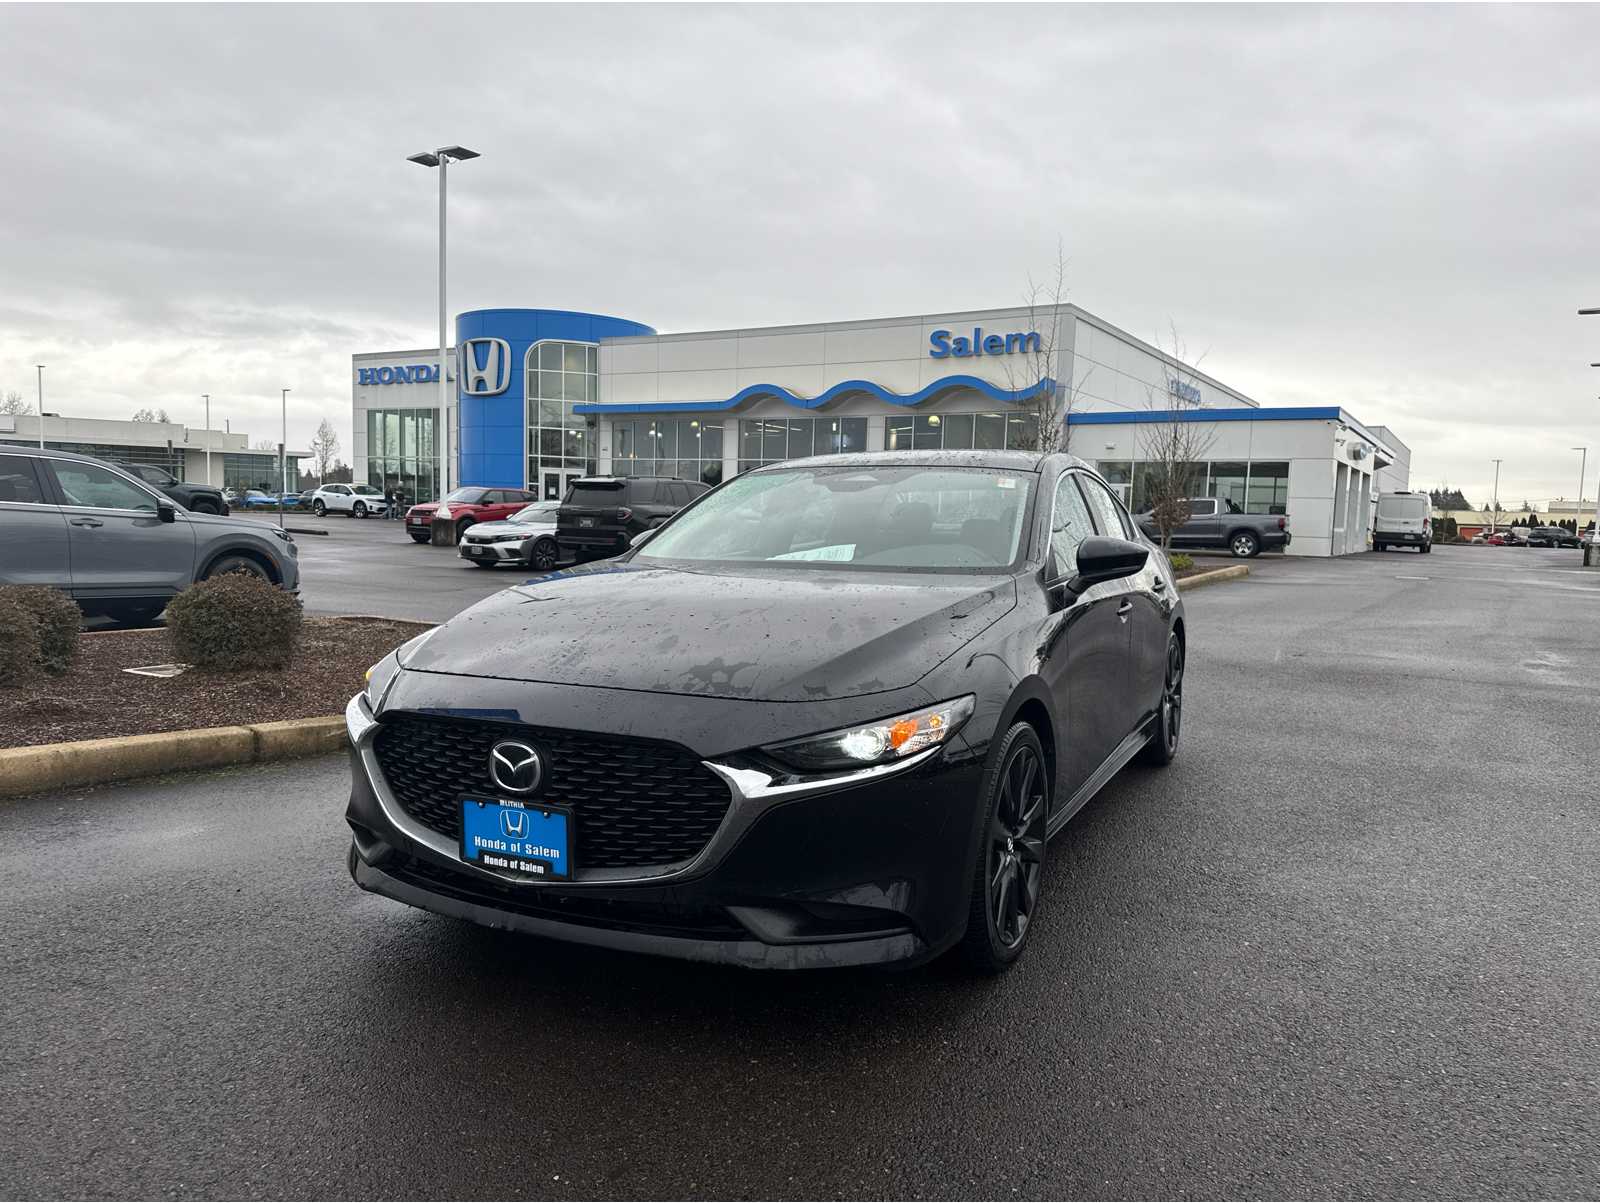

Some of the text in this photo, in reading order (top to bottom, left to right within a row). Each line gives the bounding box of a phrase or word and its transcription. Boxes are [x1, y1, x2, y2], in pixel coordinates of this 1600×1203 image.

[929, 327, 1040, 359] Salem
[474, 836, 560, 858] Honda of Salem
[484, 855, 544, 874] Honda of Salem
